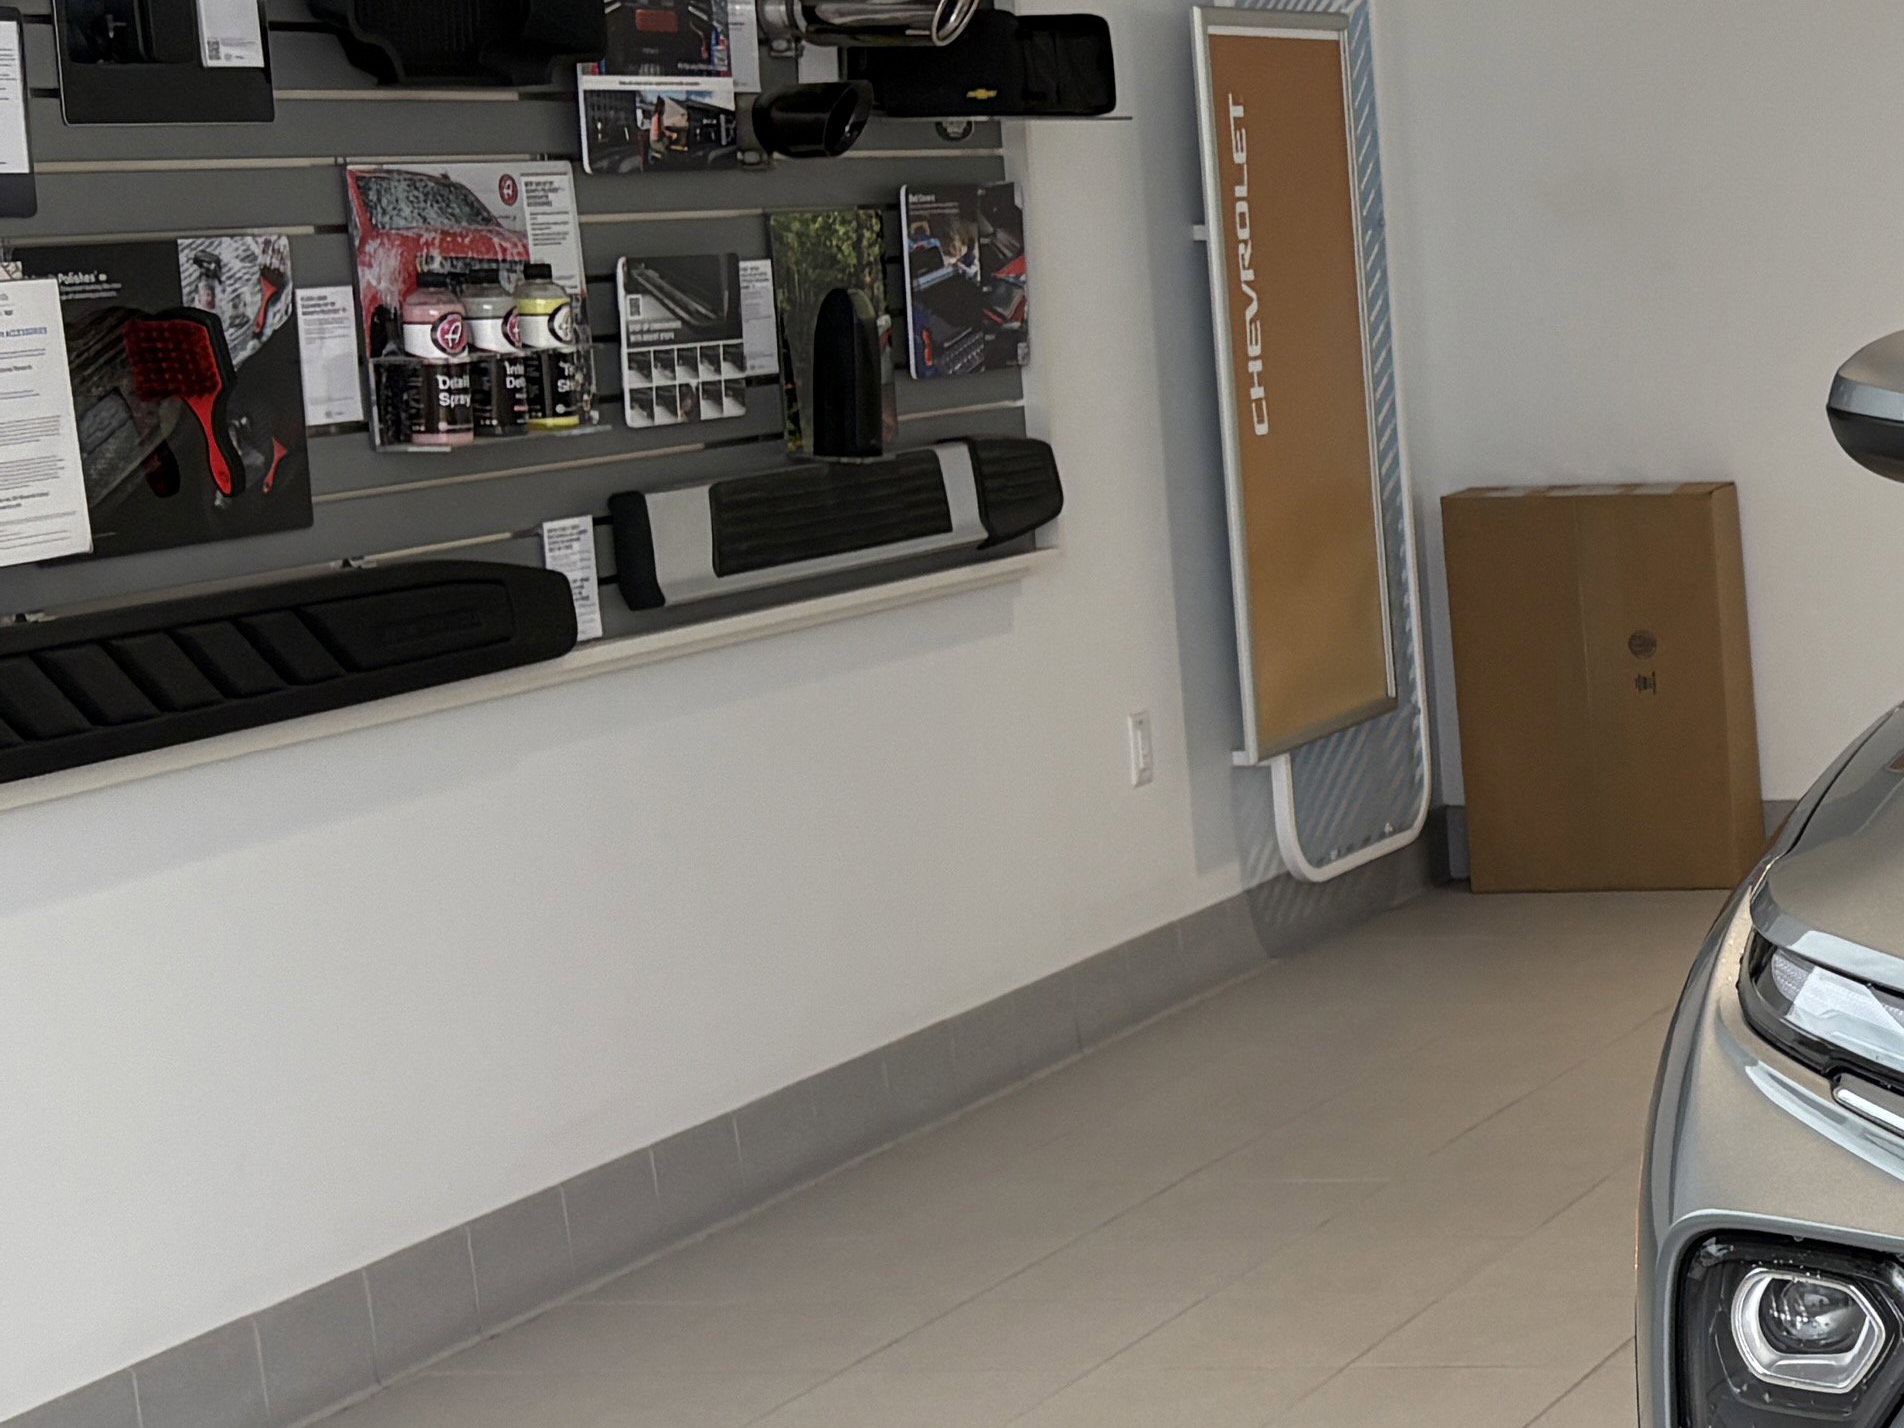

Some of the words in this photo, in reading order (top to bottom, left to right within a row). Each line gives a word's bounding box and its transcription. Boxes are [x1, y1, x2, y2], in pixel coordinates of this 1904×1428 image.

[1228, 93, 1269, 436] CHEVROLET
[436, 374, 470, 390] Detail
[438, 392, 472, 408] Spray
